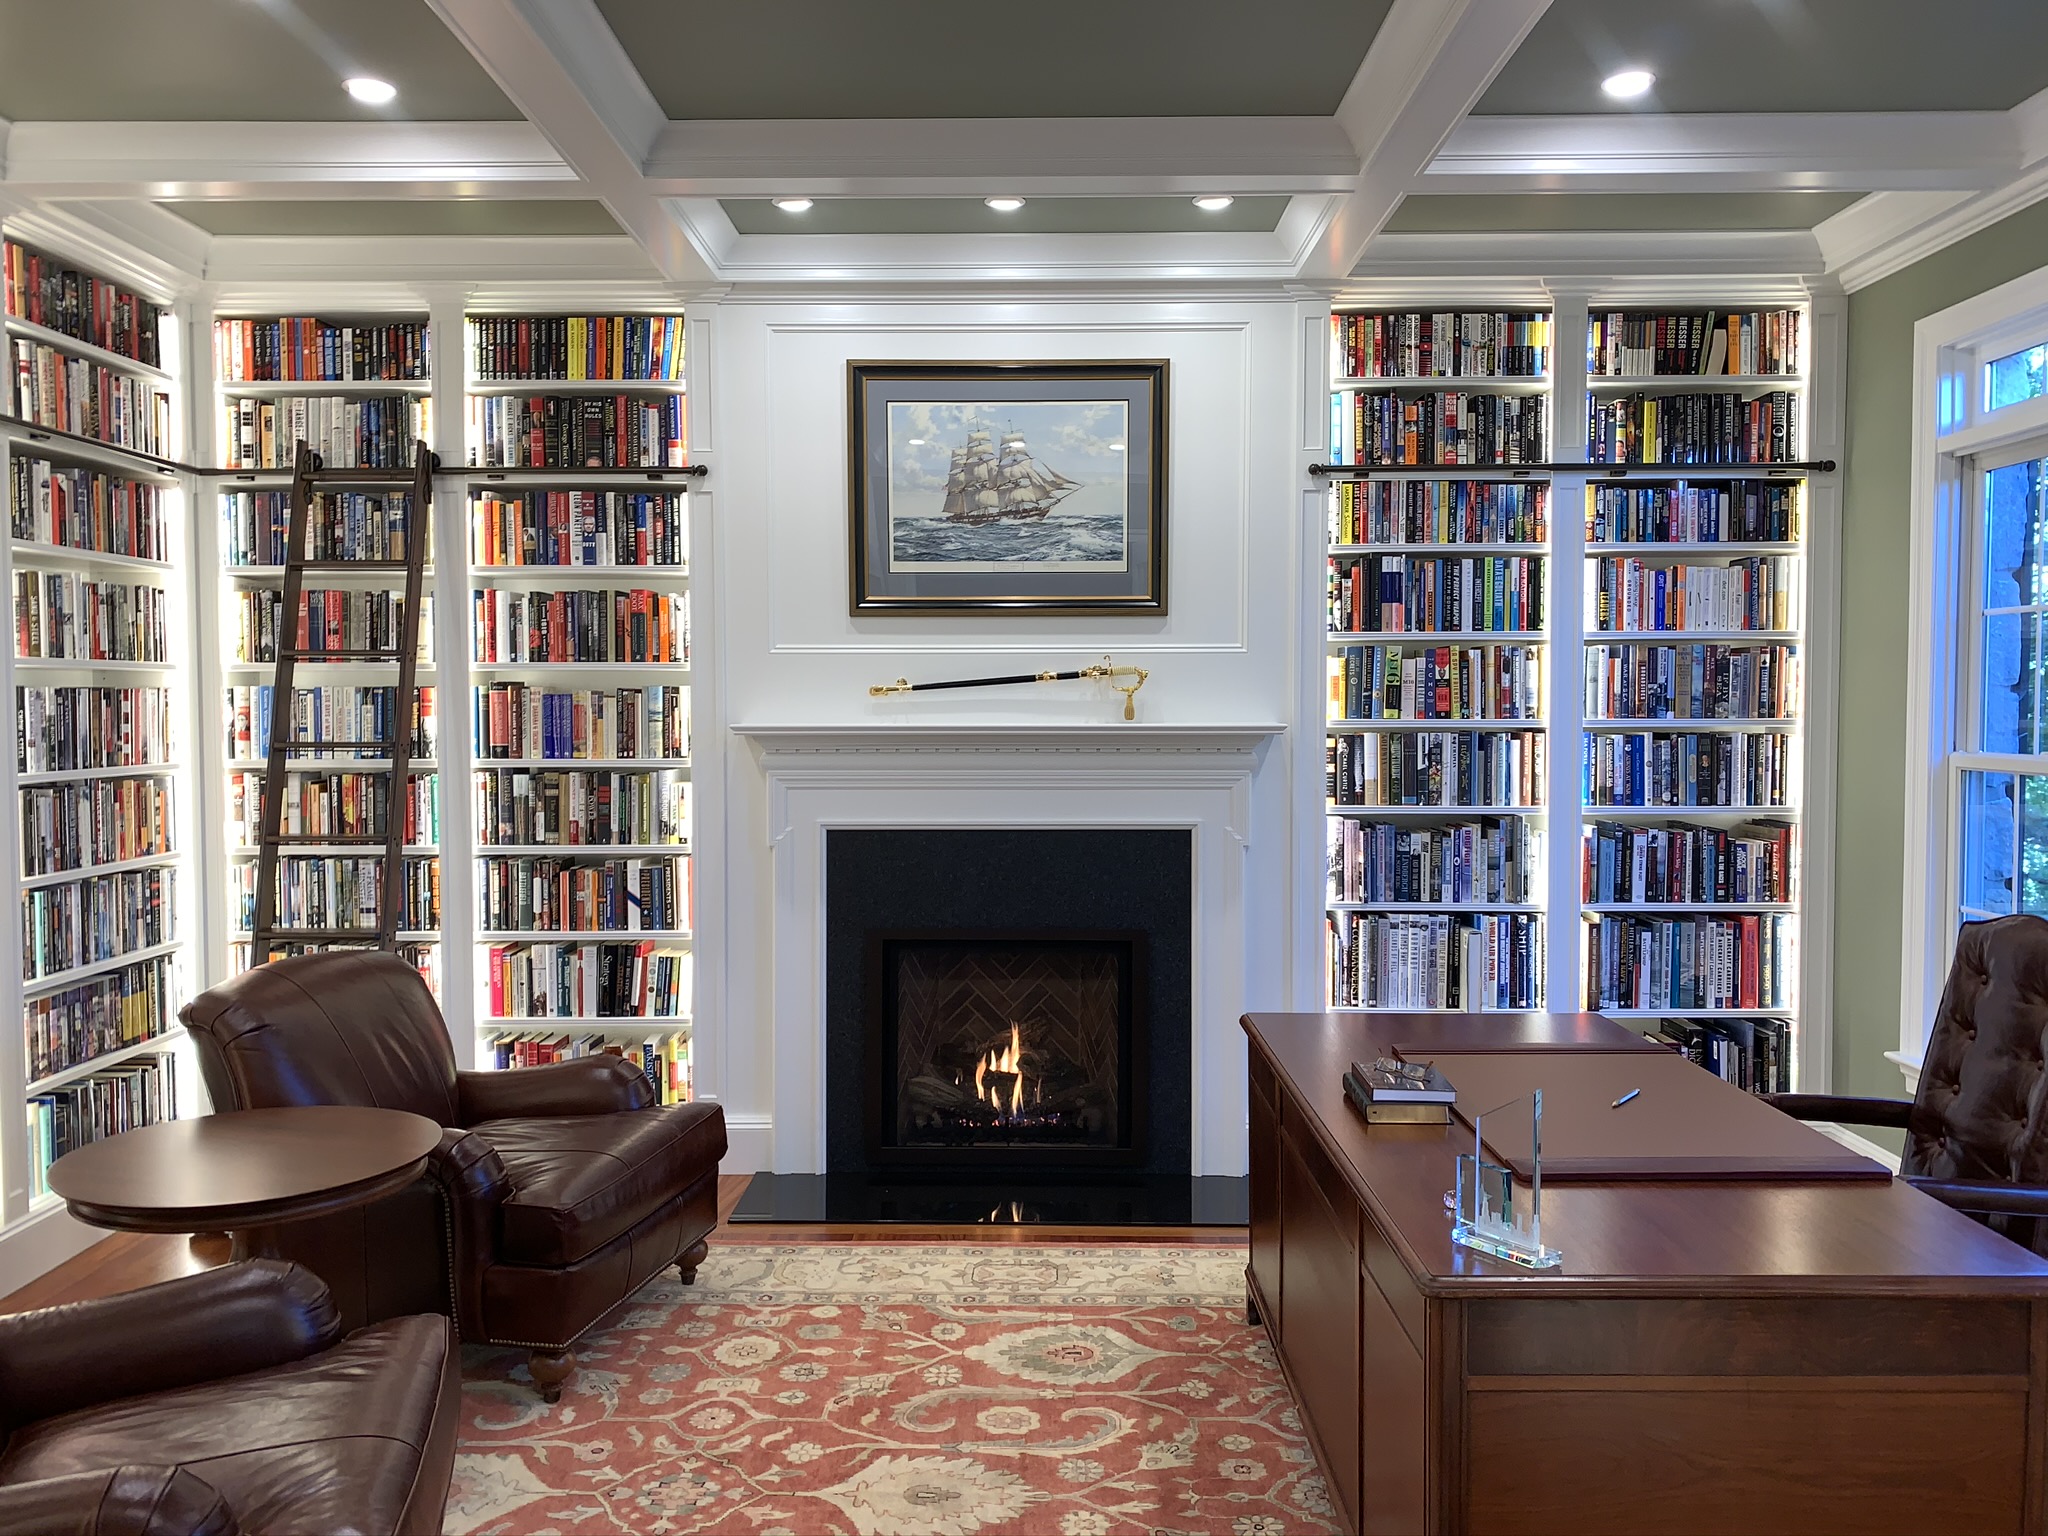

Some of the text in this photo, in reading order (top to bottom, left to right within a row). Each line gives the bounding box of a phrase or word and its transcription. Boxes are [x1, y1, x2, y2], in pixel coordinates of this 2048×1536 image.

[573, 494, 582, 537] LEON PANETTA
[1600, 592, 1609, 621] LEADERS
[1401, 854, 1409, 892] LINDBERGH
[1518, 930, 1526, 955] SHIP
[600, 955, 613, 987] Strategy
